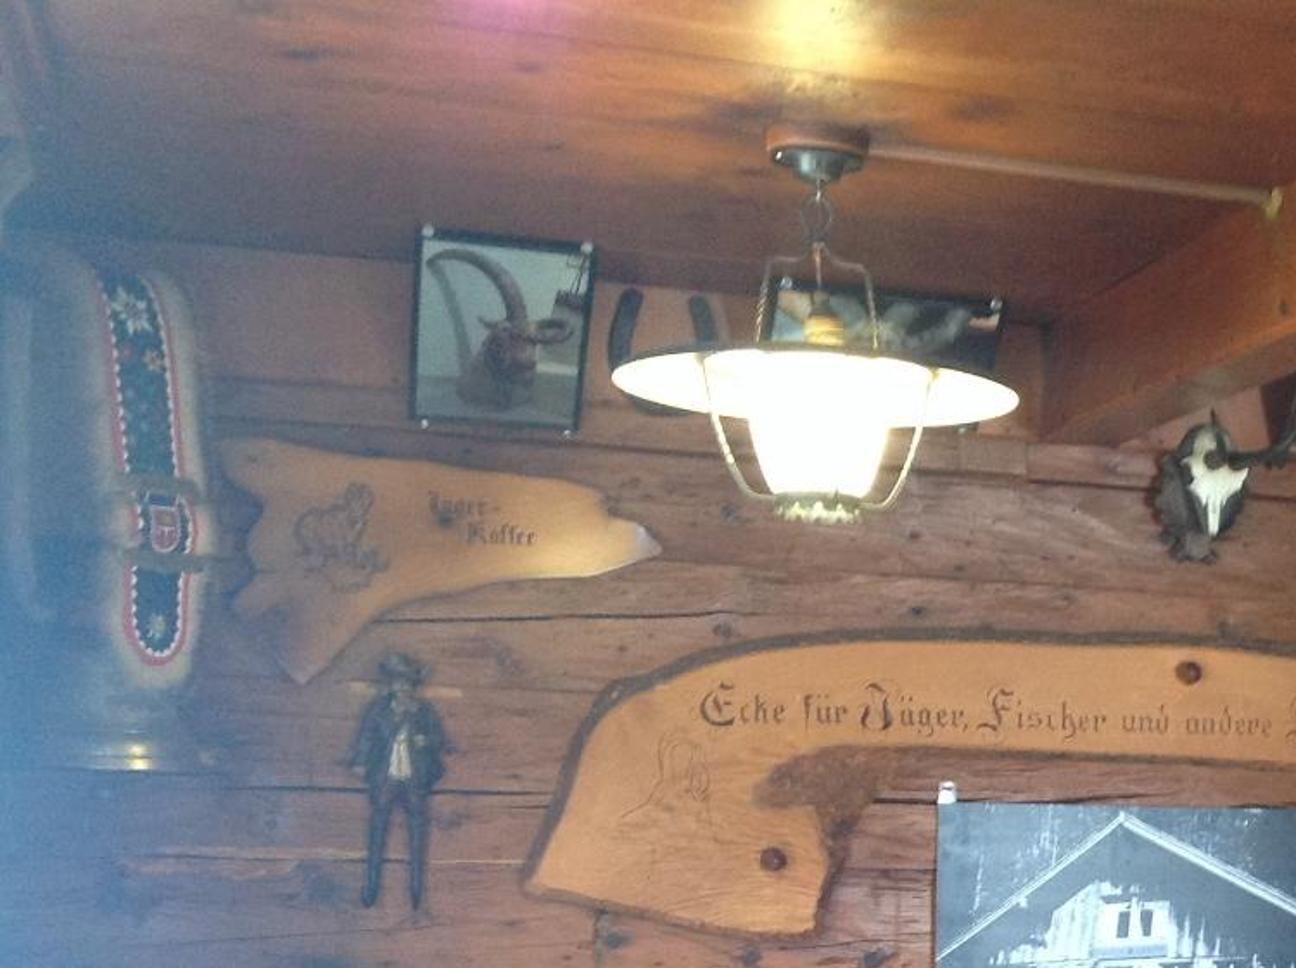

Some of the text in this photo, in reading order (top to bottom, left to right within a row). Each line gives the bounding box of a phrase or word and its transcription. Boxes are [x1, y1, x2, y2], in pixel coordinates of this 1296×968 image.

[700, 682, 786, 727] Ecke
[803, 692, 849, 732] für
[860, 682, 969, 737] Jäger,
[977, 687, 1107, 740] Fischer
[1122, 704, 1169, 734] und
[1186, 705, 1273, 738] andere
